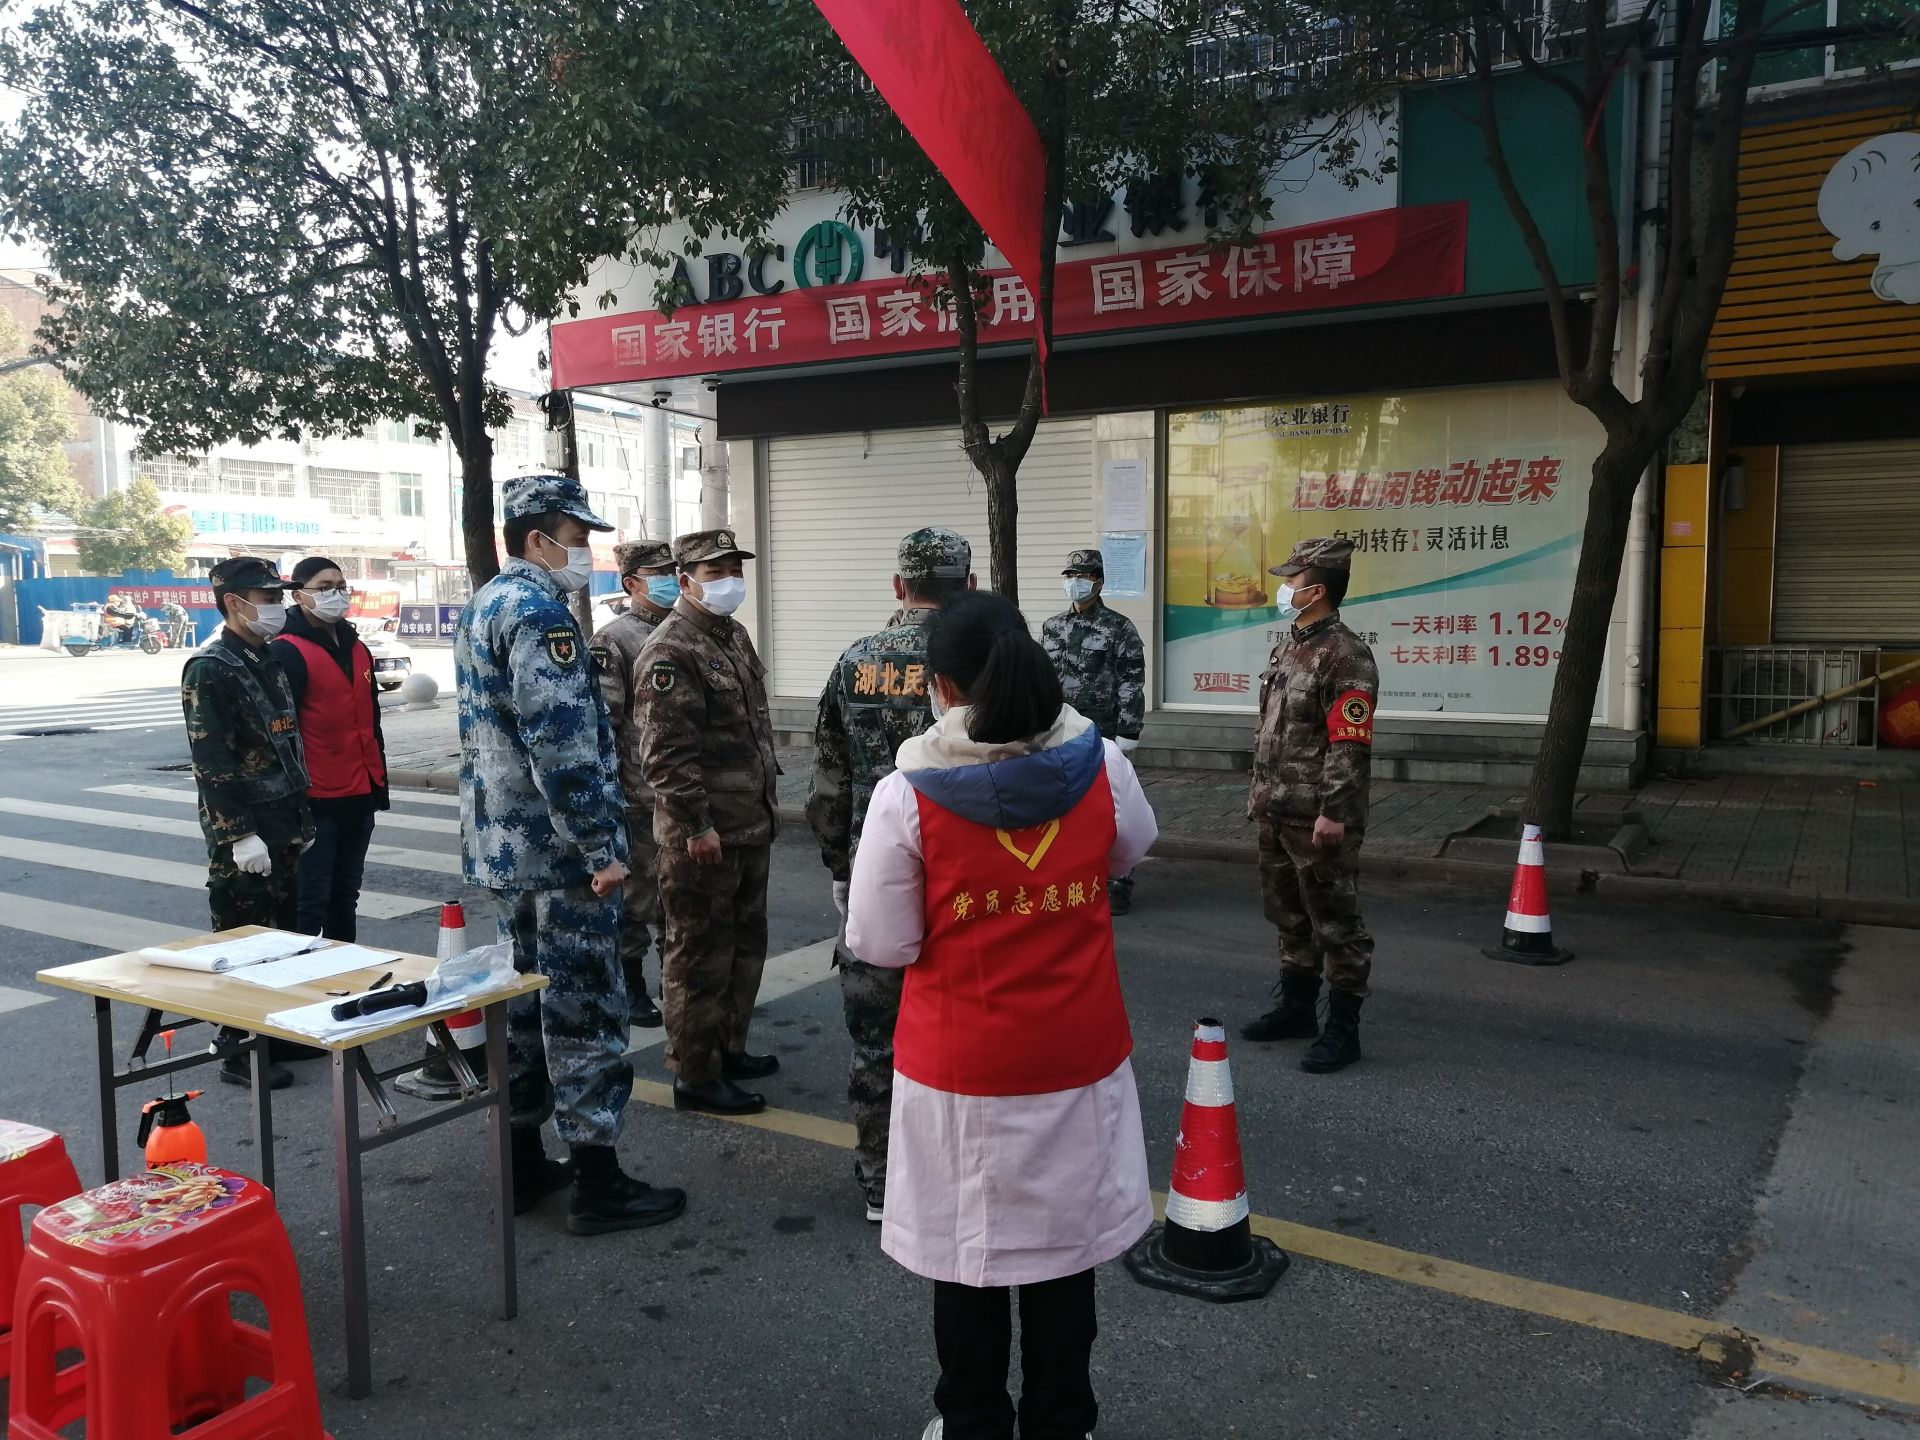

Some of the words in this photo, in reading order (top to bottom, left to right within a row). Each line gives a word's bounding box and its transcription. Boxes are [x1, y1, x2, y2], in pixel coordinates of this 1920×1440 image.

[671, 244, 785, 307] ABC
[611, 307, 786, 369] 国家银行
[1090, 232, 1356, 315] 国家保障
[1292, 456, 1563, 511] 让您的闲钱动起来
[1426, 524, 1510, 551] 灵活计息
[401, 622, 433, 634] 治安岗亭
[1390, 614, 1478, 635] 一天利率
[1390, 645, 1477, 665] 七天利率
[854, 662, 925, 696] 湖北民
